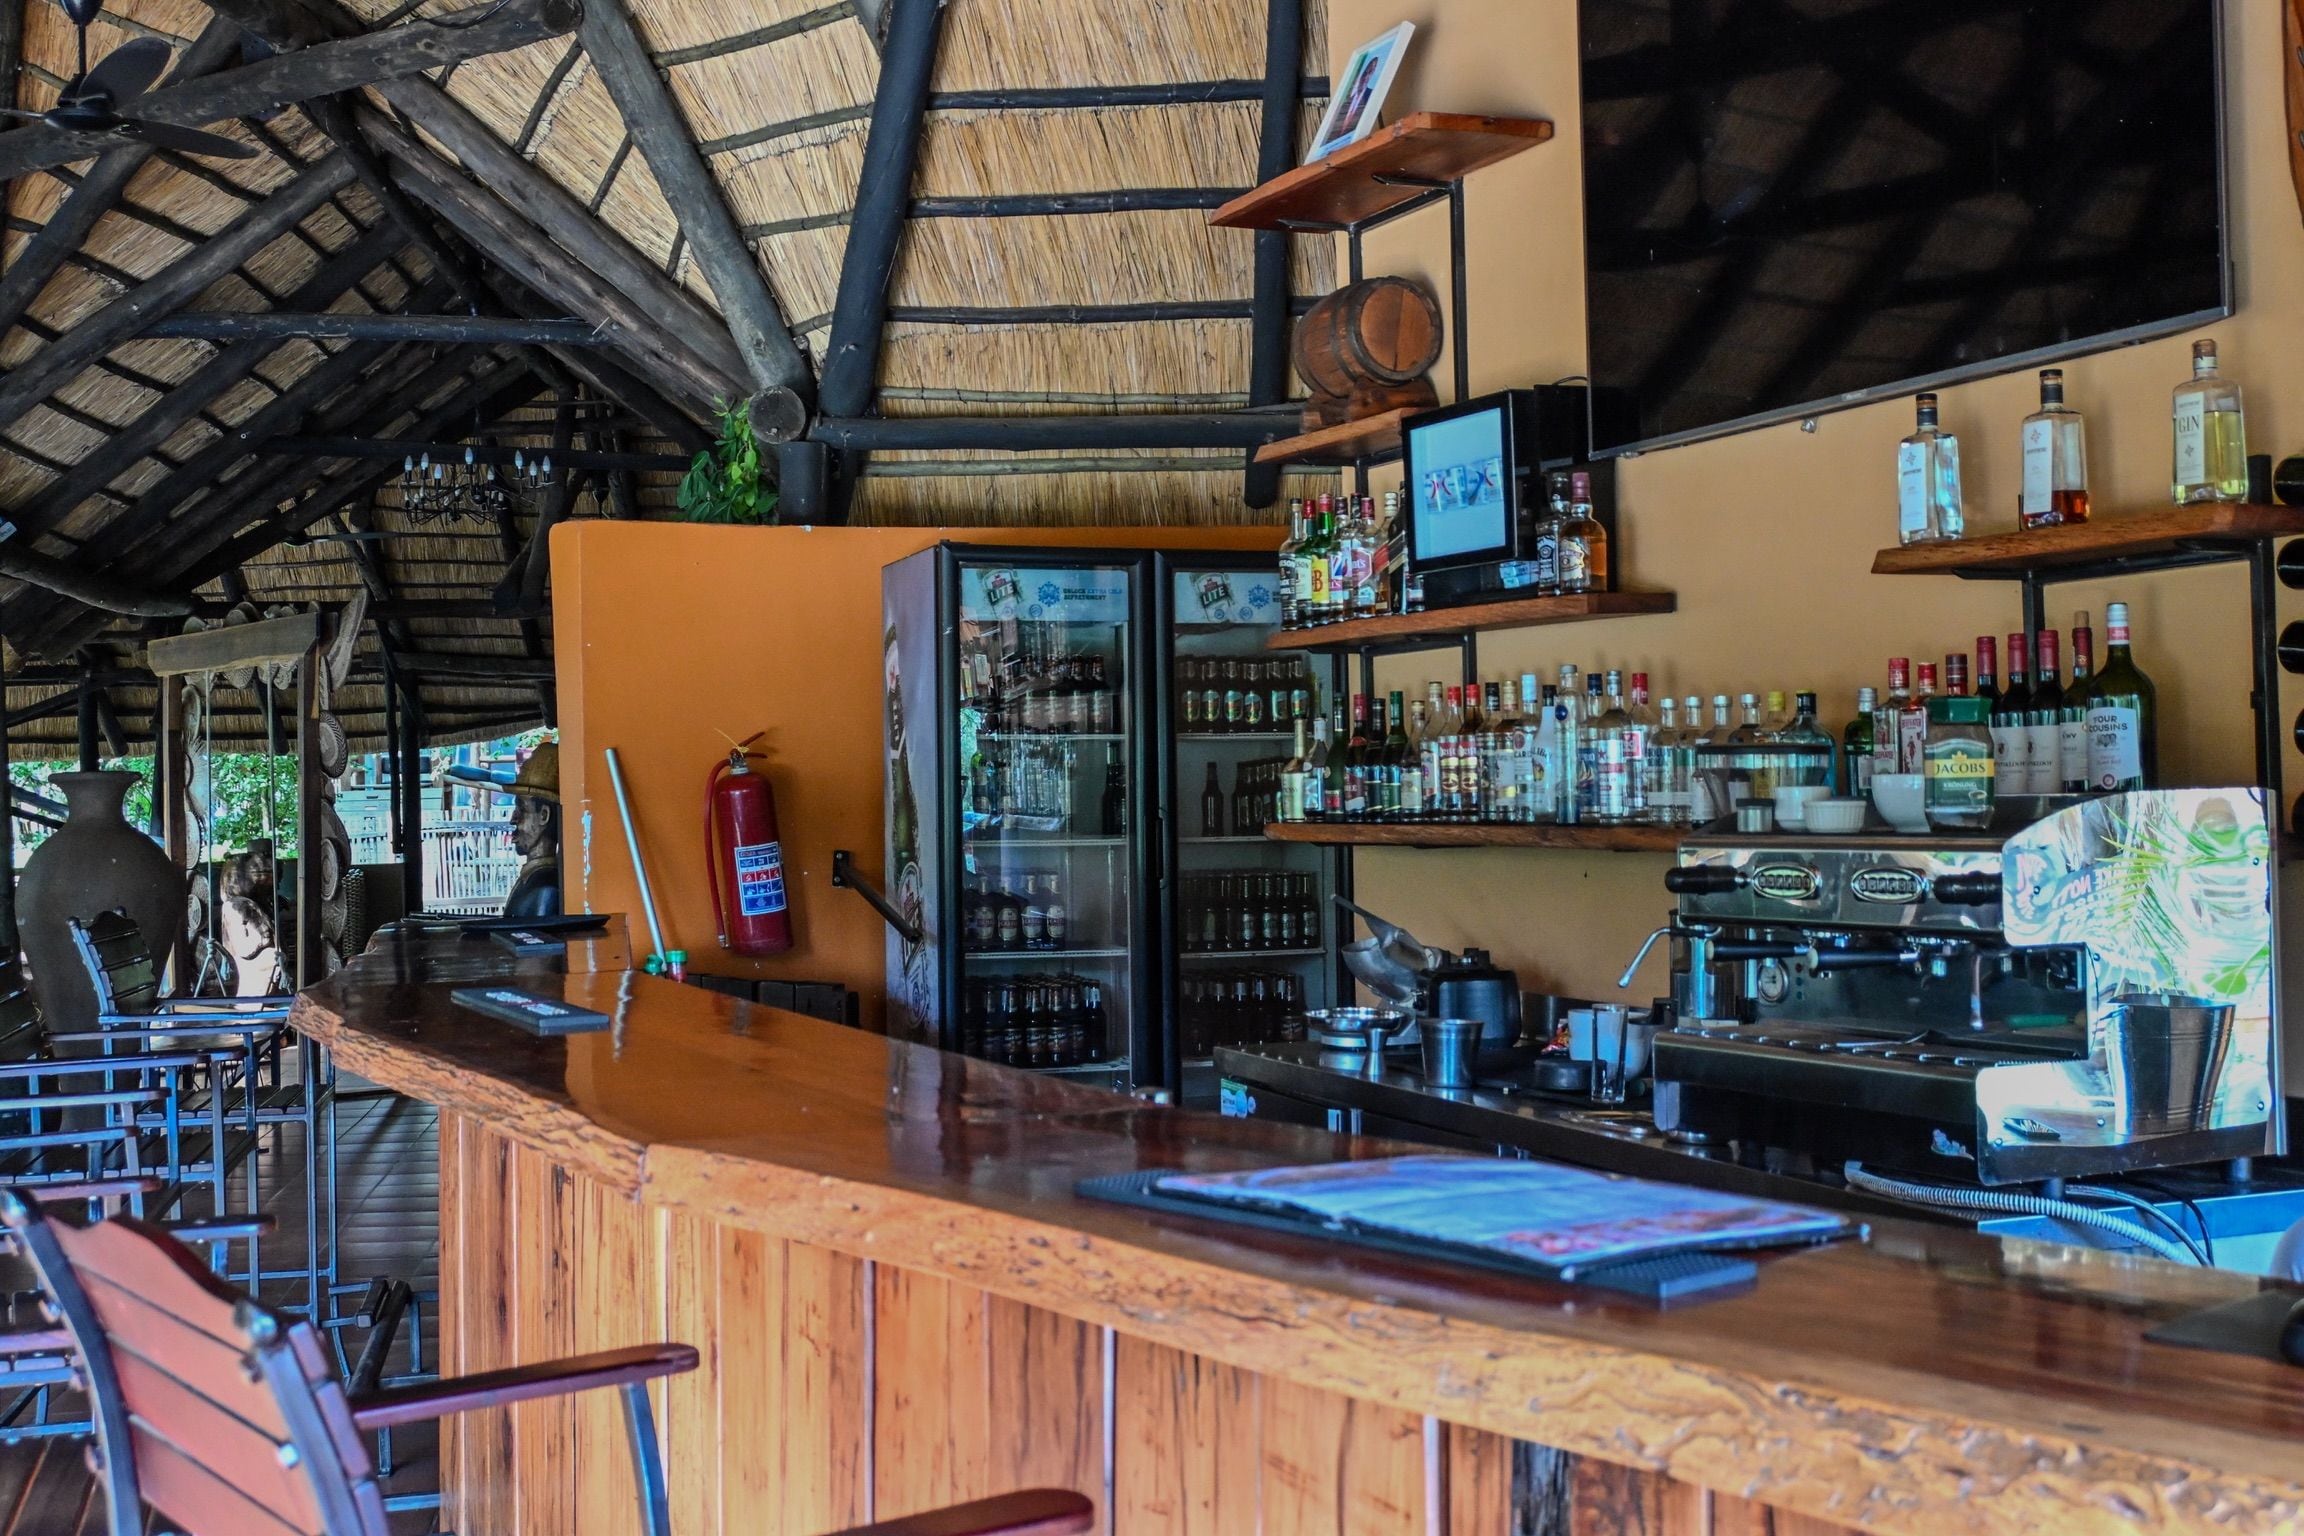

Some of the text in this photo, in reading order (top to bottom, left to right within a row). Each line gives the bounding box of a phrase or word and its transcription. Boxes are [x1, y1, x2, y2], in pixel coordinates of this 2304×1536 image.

[2178, 415, 2200, 433] GIN
[990, 583, 1016, 603] LITE
[1202, 585, 1226, 605] LITE
[2088, 723, 2128, 733] COUSINS
[1936, 763, 1986, 774] JACOBS
